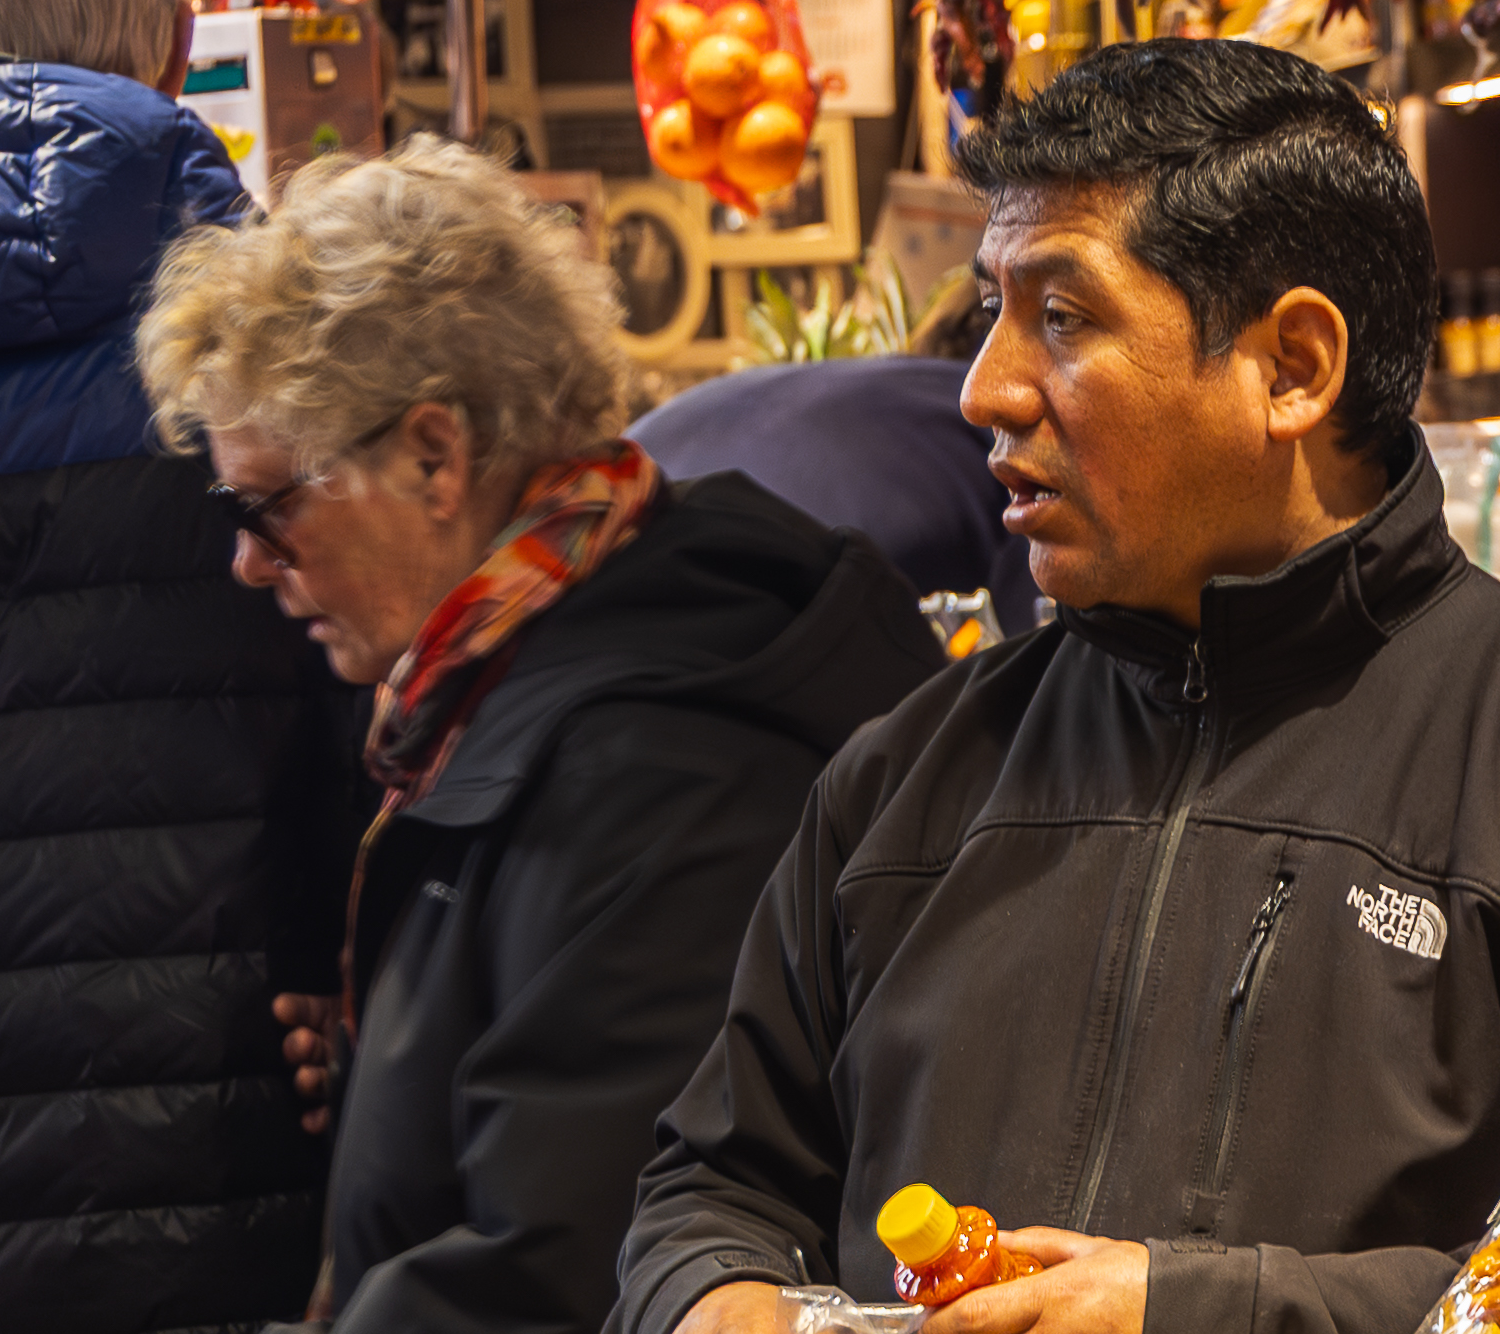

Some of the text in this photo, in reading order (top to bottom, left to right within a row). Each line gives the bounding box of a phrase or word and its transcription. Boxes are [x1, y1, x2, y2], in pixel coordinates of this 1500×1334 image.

[1346, 885, 1415, 933] NORTH
[1379, 883, 1421, 916] THE
[1358, 911, 1411, 951] FACE
